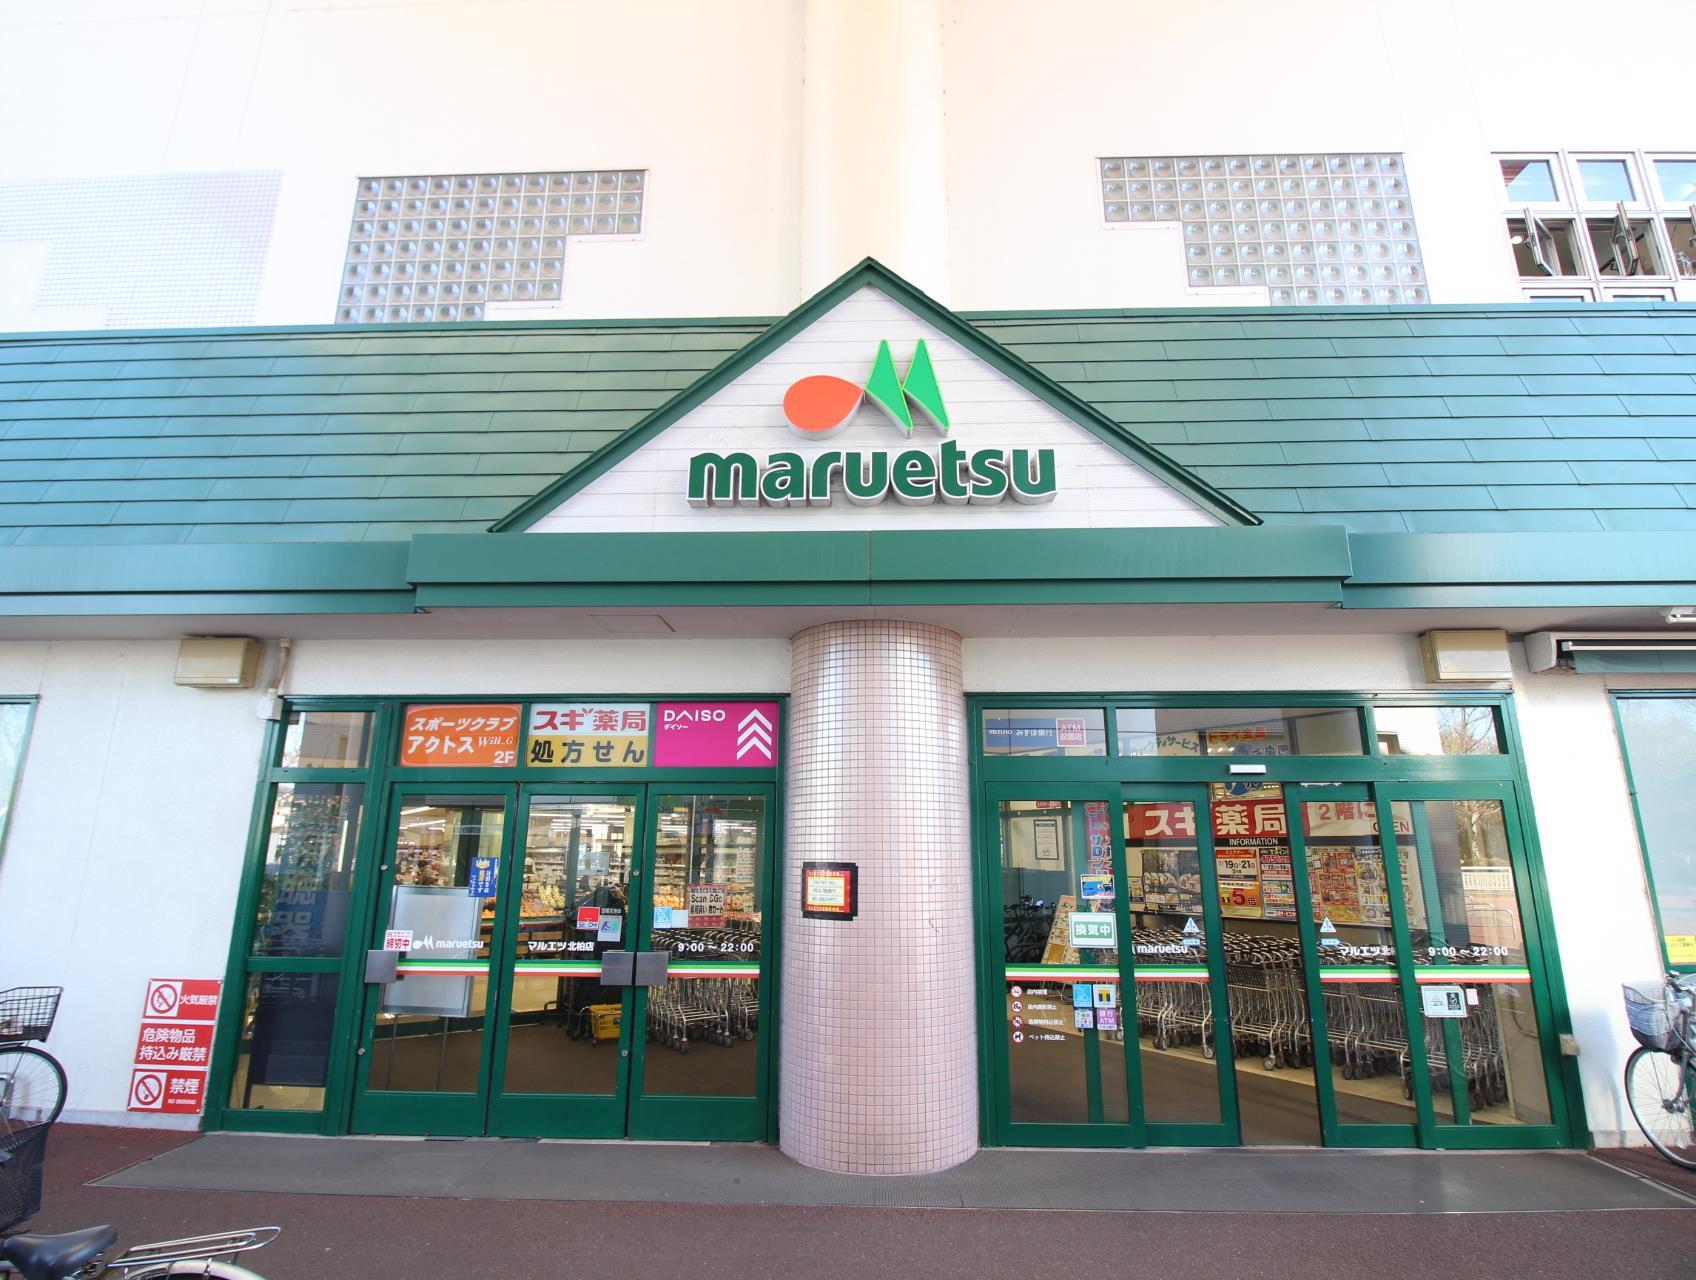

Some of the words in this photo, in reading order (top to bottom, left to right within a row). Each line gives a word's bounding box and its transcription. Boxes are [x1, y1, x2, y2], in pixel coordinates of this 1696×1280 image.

[687, 439, 1058, 506] maruetsu
[533, 708, 647, 732] スギ薬局
[663, 709, 726, 722] DAISO
[409, 716, 518, 732] スポーツクラブ
[663, 723, 688, 731] ダイソー
[1061, 724, 1081, 732] ATM
[1015, 728, 1054, 737] みずほ銀行
[407, 735, 475, 755] アクトス
[530, 738, 645, 764] 処方せん
[493, 750, 515, 764] 2F
[1229, 837, 1278, 846] INFORMATION
[1074, 923, 1112, 936] 換気中
[435, 940, 484, 949] maruetsu
[527, 941, 595, 952] マルエツ北柏店
[677, 943, 705, 952] 9:00
[720, 943, 754, 952] 22:00
[1137, 943, 1188, 954] maruetsu
[1428, 947, 1456, 957] 9:00
[1472, 947, 1508, 956] 22:00
[179, 994, 218, 1006] 火気厳禁
[142, 1027, 196, 1044] 危険物品
[138, 1045, 208, 1062] 持込み厳禁
[169, 1077, 201, 1095] 禁煙
